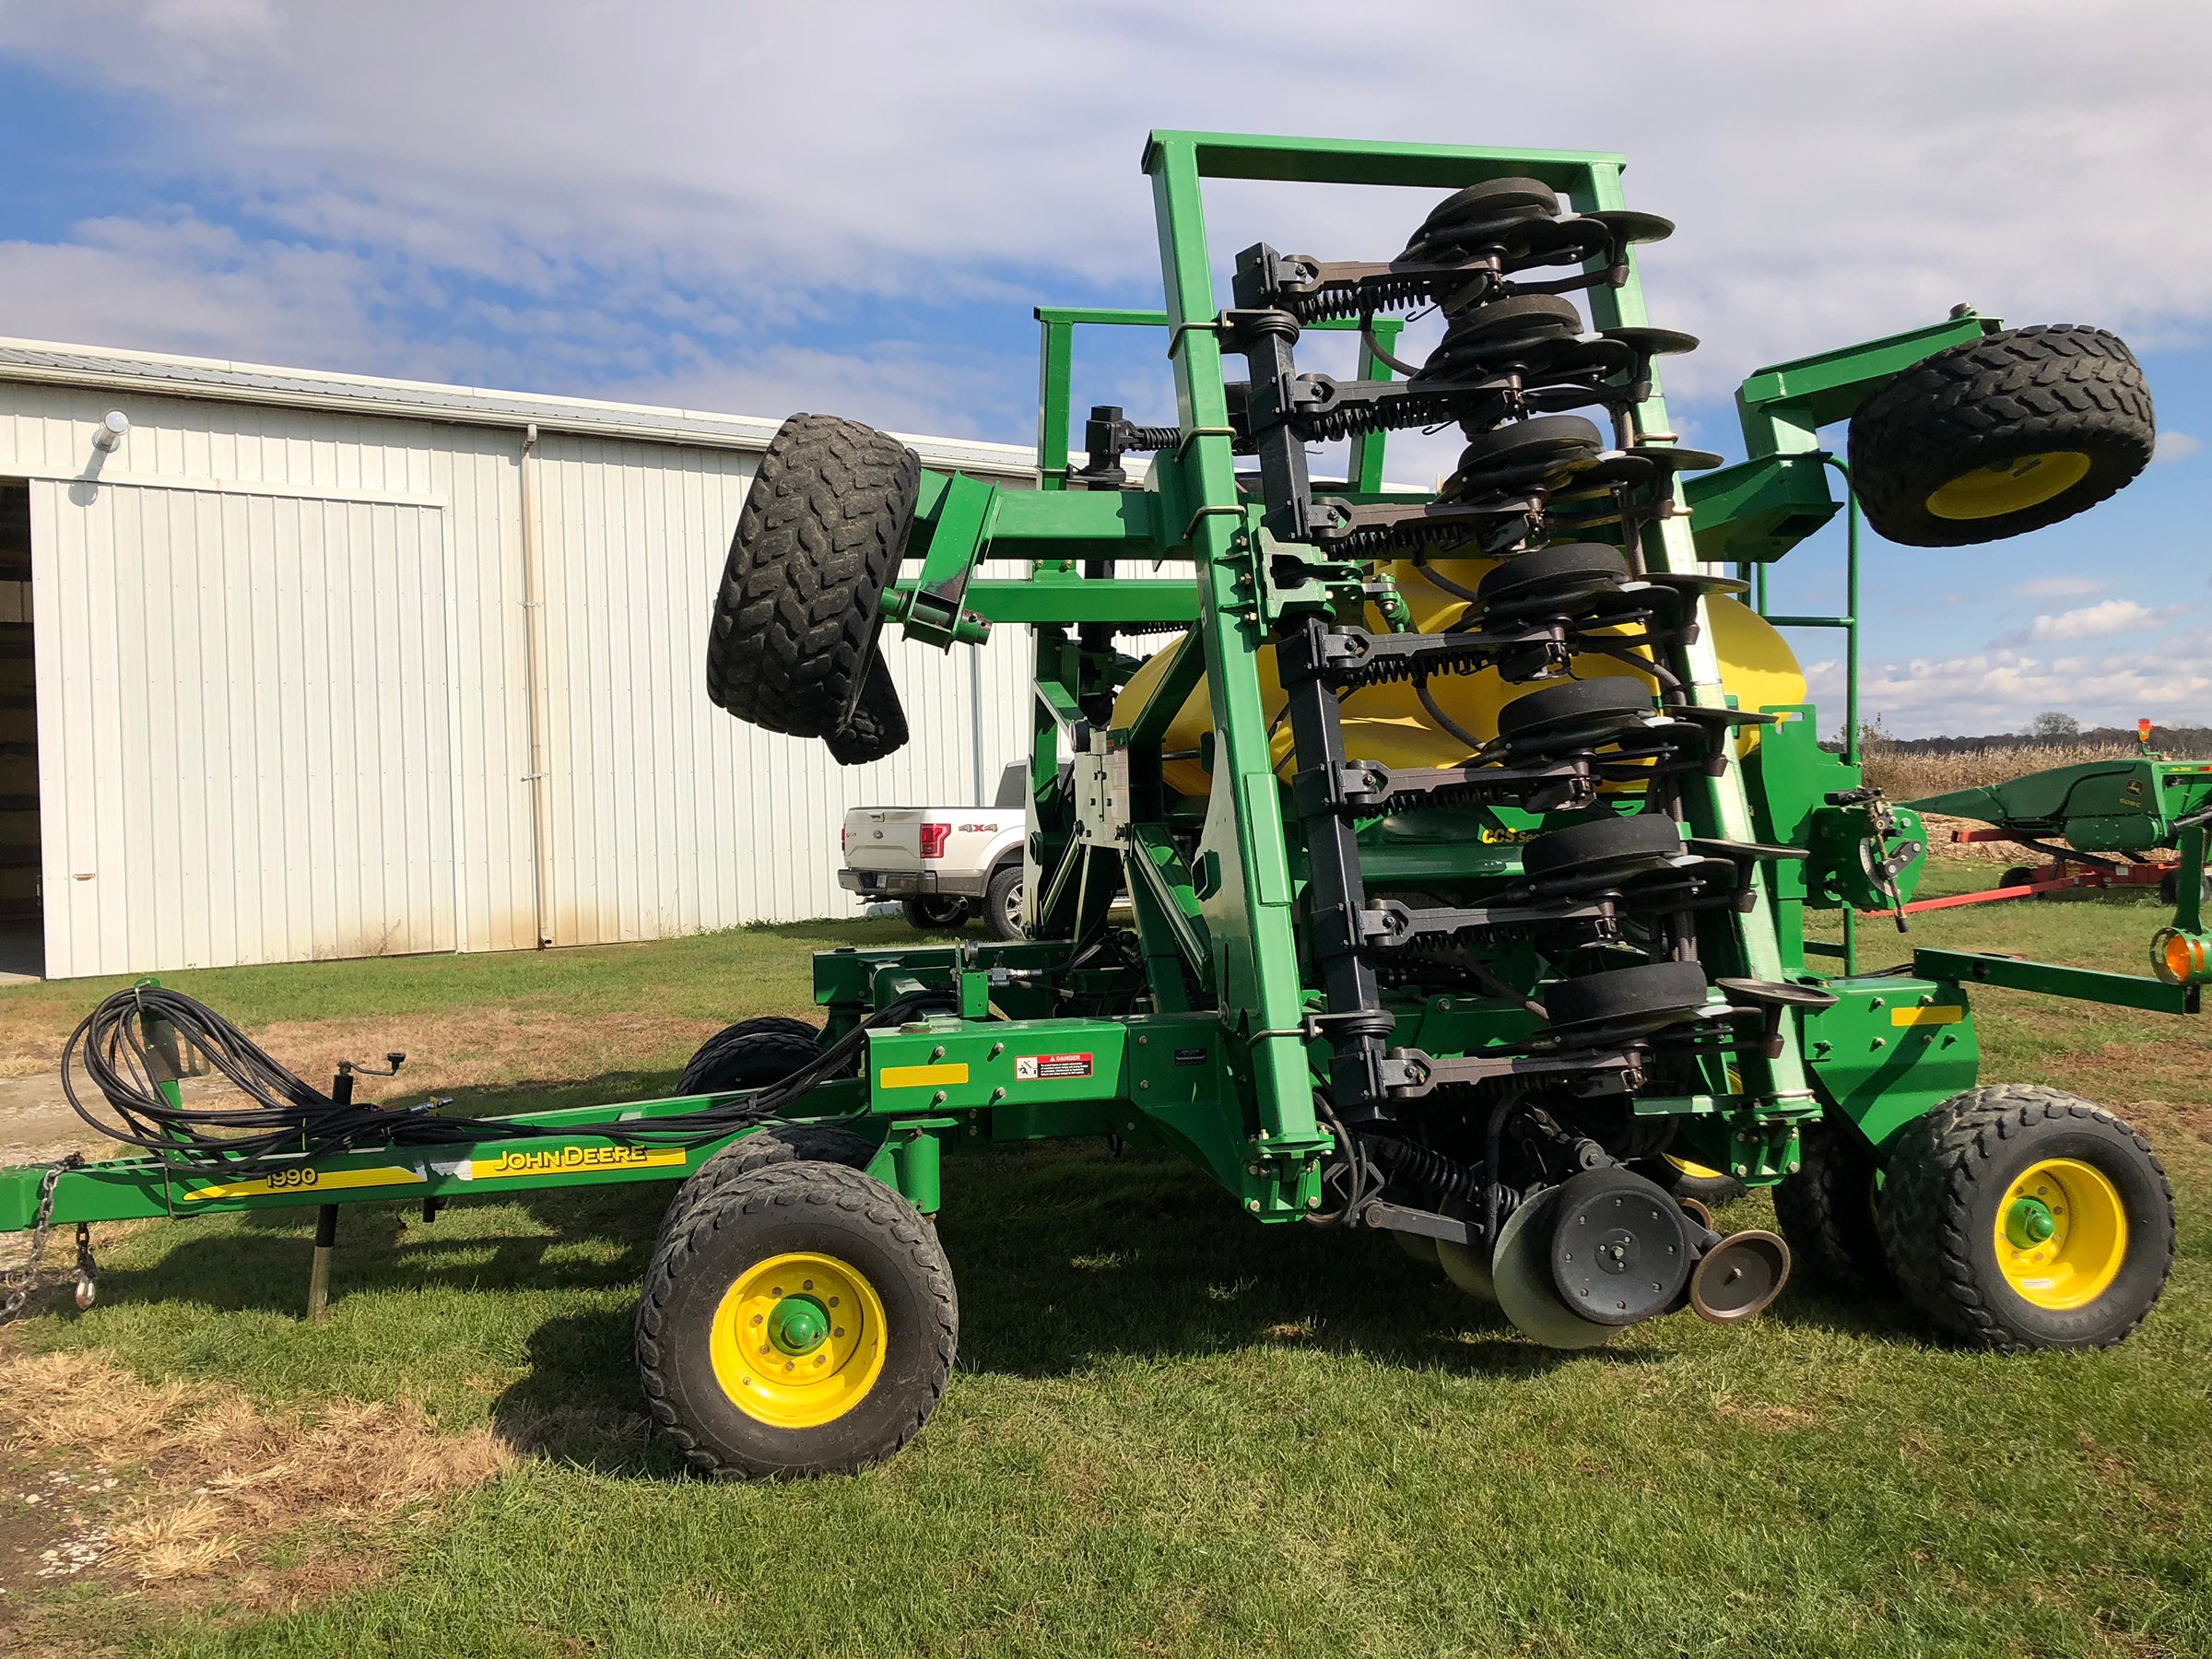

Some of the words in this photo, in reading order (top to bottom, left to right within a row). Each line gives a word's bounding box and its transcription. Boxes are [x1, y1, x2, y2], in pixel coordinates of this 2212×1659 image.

[1482, 827, 1516, 844] CCS
[494, 1150, 560, 1171] JOHN
[563, 1145, 647, 1167] DEERE
[265, 1167, 318, 1188] 1990
